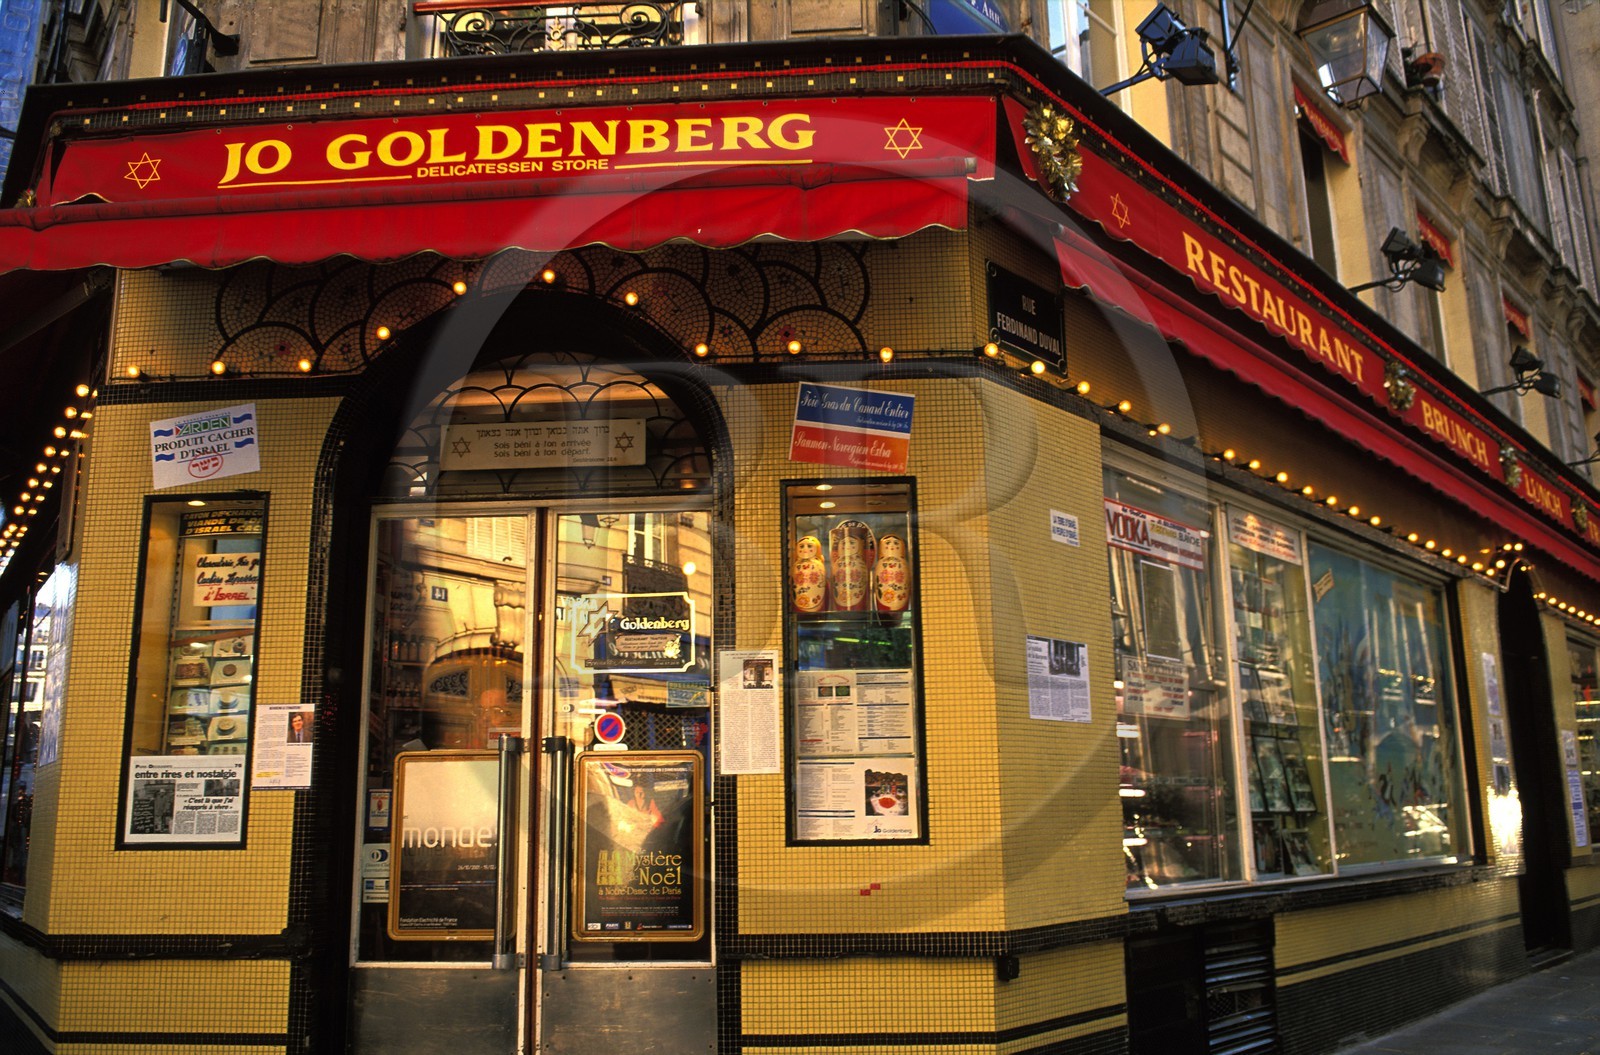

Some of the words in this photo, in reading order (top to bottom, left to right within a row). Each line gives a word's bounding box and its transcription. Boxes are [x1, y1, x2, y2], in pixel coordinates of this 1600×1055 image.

[218, 140, 293, 184] JO
[326, 113, 817, 171] GOLDENBERG
[416, 161, 543, 178] DELICATESSEN
[552, 159, 609, 172] STORE
[1022, 295, 1036, 315] RUE
[1182, 231, 1364, 383] RESTAURANT
[996, 311, 1038, 345] FERDINAND
[1039, 331, 1061, 356] DUVAL
[853, 396, 885, 415] Canard
[884, 400, 909, 419] Entier
[175, 415, 231, 437] YARDEN
[1421, 400, 1490, 467] BRUNCH
[154, 436, 205, 452] PRODUIT
[208, 426, 254, 443] CACHER
[494, 441, 510, 449] Sois
[514, 440, 531, 449] béni
[561, 439, 591, 447] arrivée
[180, 443, 230, 459] D'ISRAEL
[494, 450, 510, 458] Sois
[1524, 473, 1563, 519] LUNCH
[185, 526, 233, 535] D'ISRAEL
[187, 518, 226, 527] VIANDE
[1106, 508, 1151, 547] VODKA
[619, 616, 690, 632] Goldenberg
[135, 770, 158, 779] entre
[161, 769, 182, 779] rires
[184, 770, 194, 778] et
[197, 769, 237, 780] nostalgie
[639, 866, 682, 885] Noël
[649, 886, 660, 895] de
[662, 886, 682, 895] Paris
